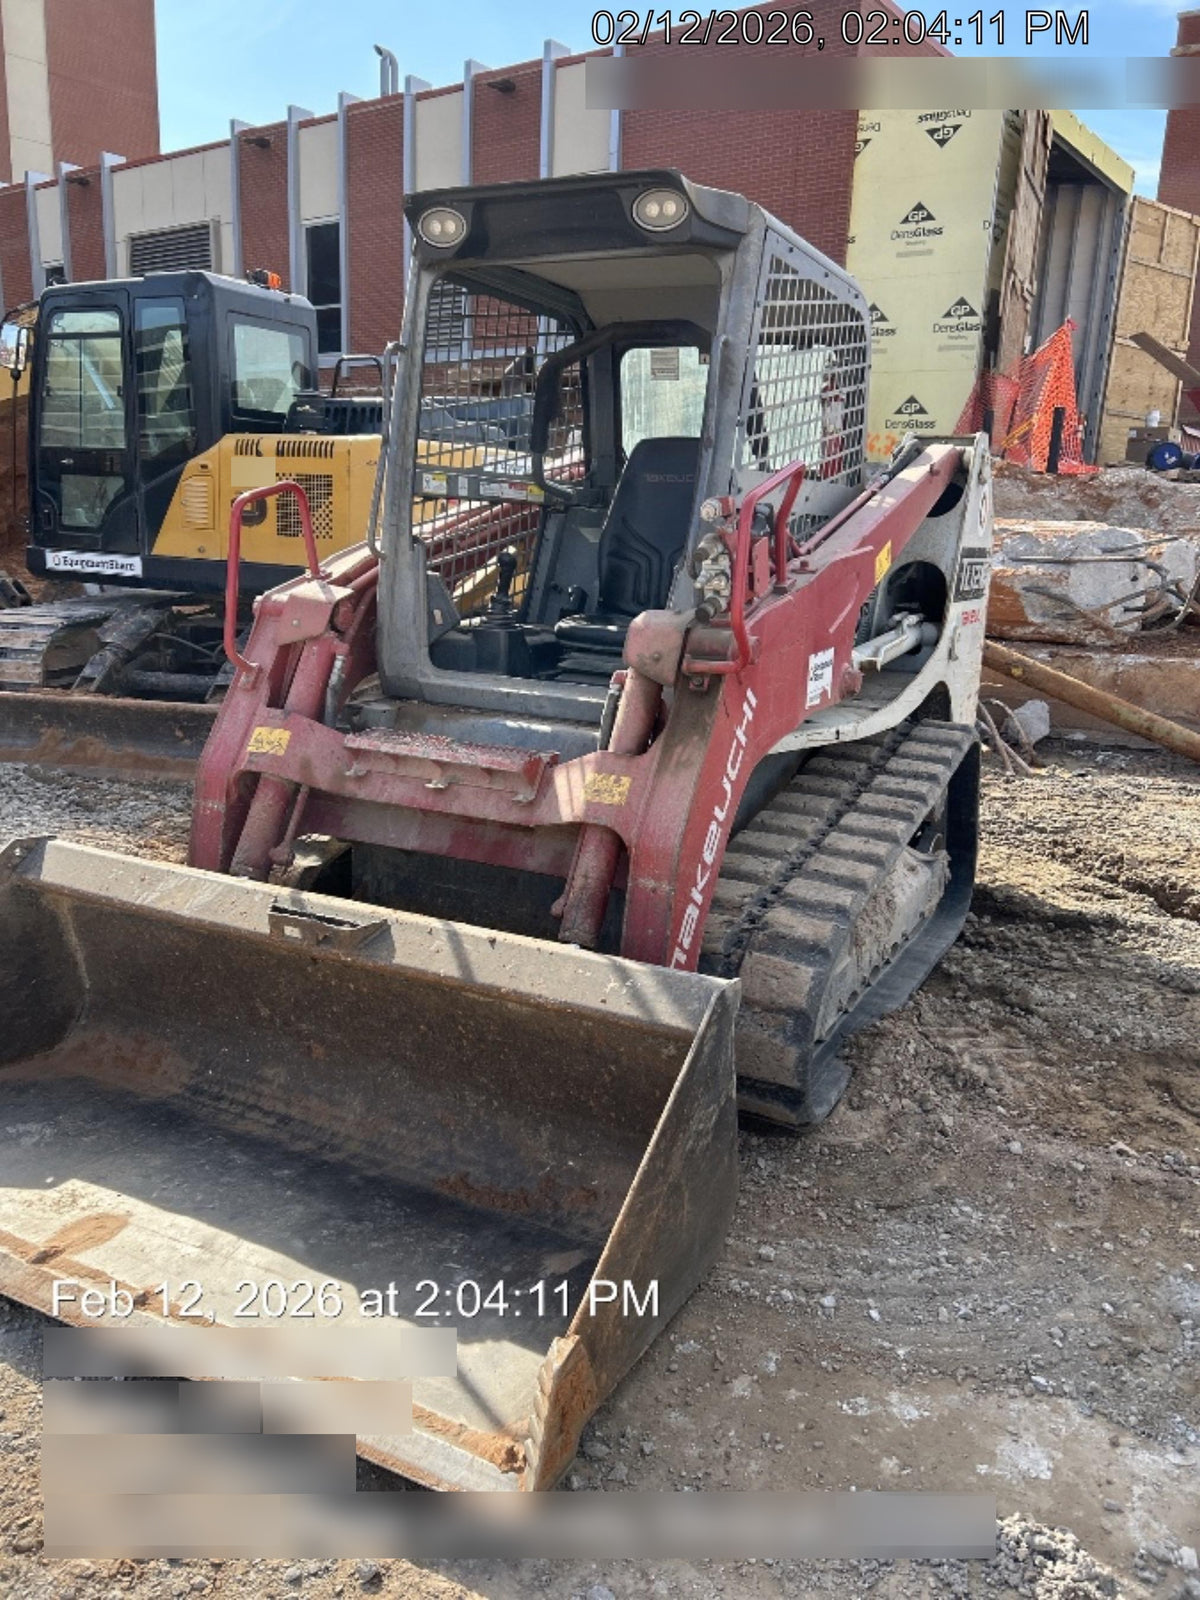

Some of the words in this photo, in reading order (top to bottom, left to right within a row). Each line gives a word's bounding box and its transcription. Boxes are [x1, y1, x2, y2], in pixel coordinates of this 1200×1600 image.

[907, 210, 928, 222] GP
[890, 226, 943, 241] DensGlass
[950, 305, 970, 316] GP
[900, 403, 921, 414] GP
[885, 418, 937, 430] DensGlass
